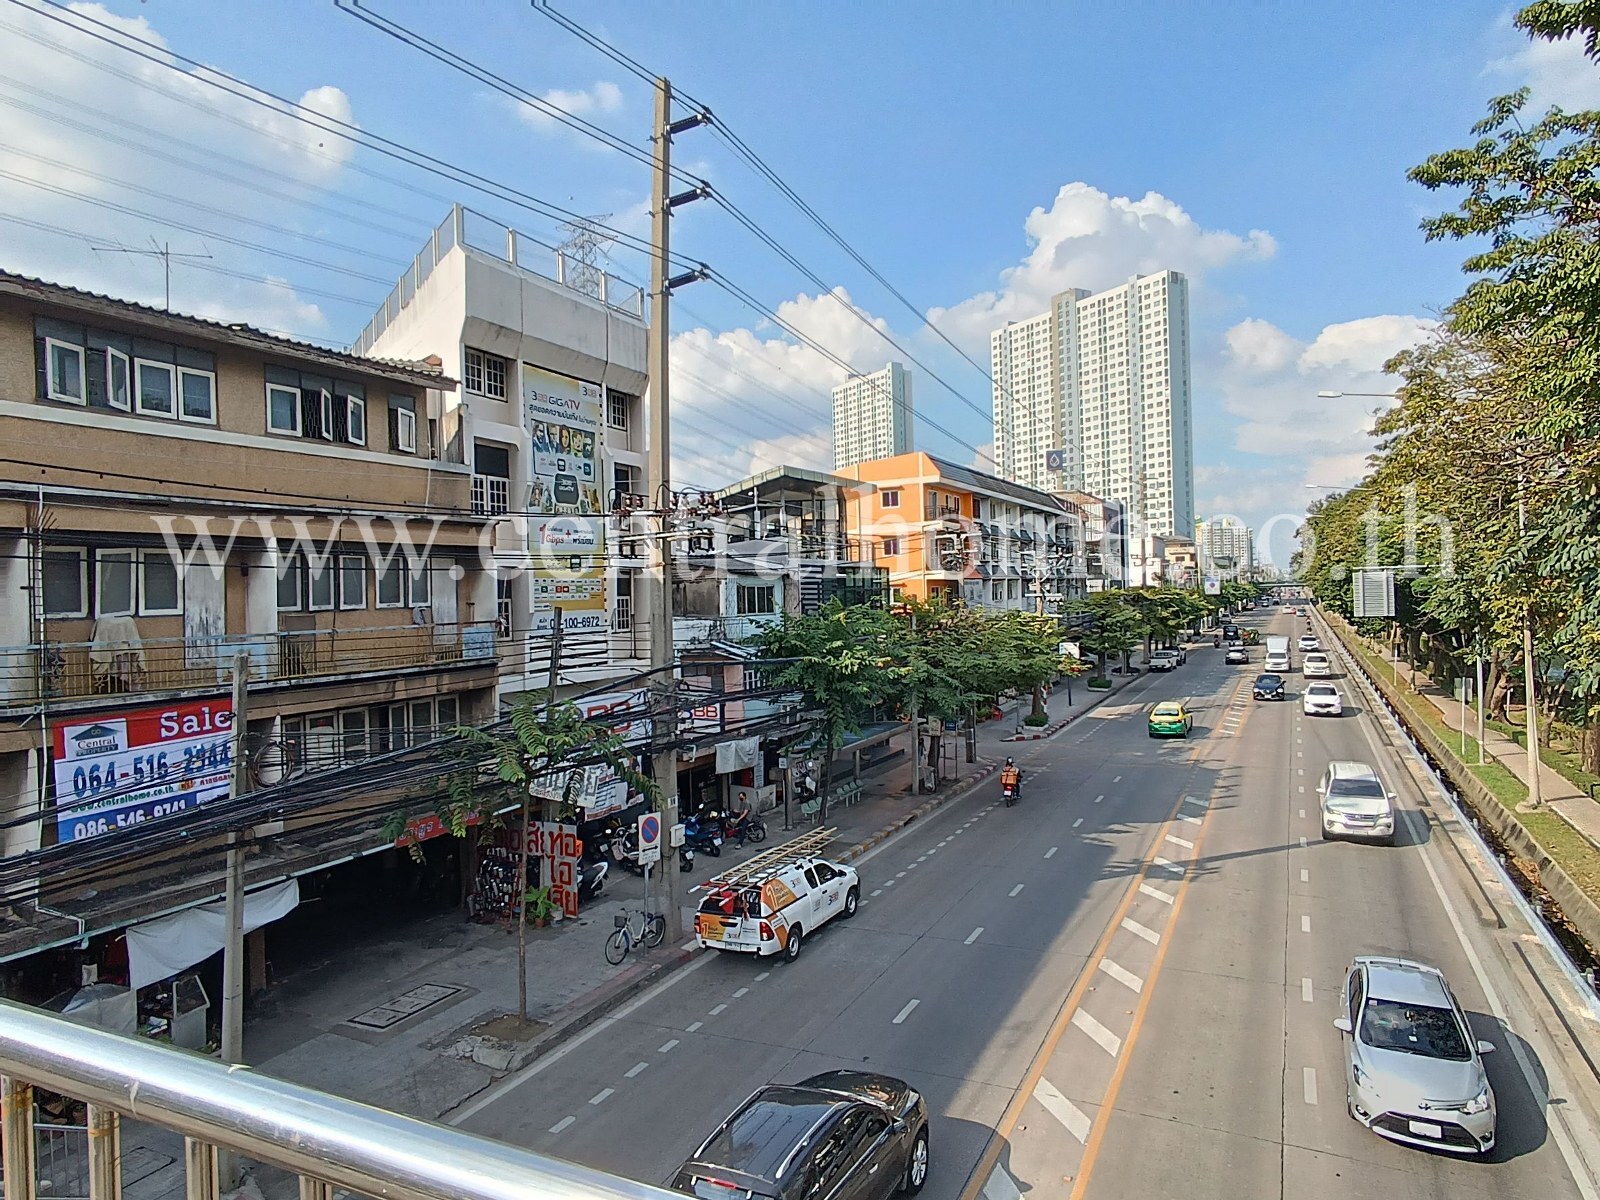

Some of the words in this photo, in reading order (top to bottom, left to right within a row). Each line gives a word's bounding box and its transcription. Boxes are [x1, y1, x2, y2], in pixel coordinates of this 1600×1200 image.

[548, 396, 581, 411] GIGATV
[549, 616, 600, 630] 0-100-6972
[160, 706, 232, 738] Sale
[77, 736, 116, 750] Central
[76, 745, 119, 757] PROPERTY
[548, 824, 577, 858] ท่อ
[545, 853, 572, 885] ไอ
